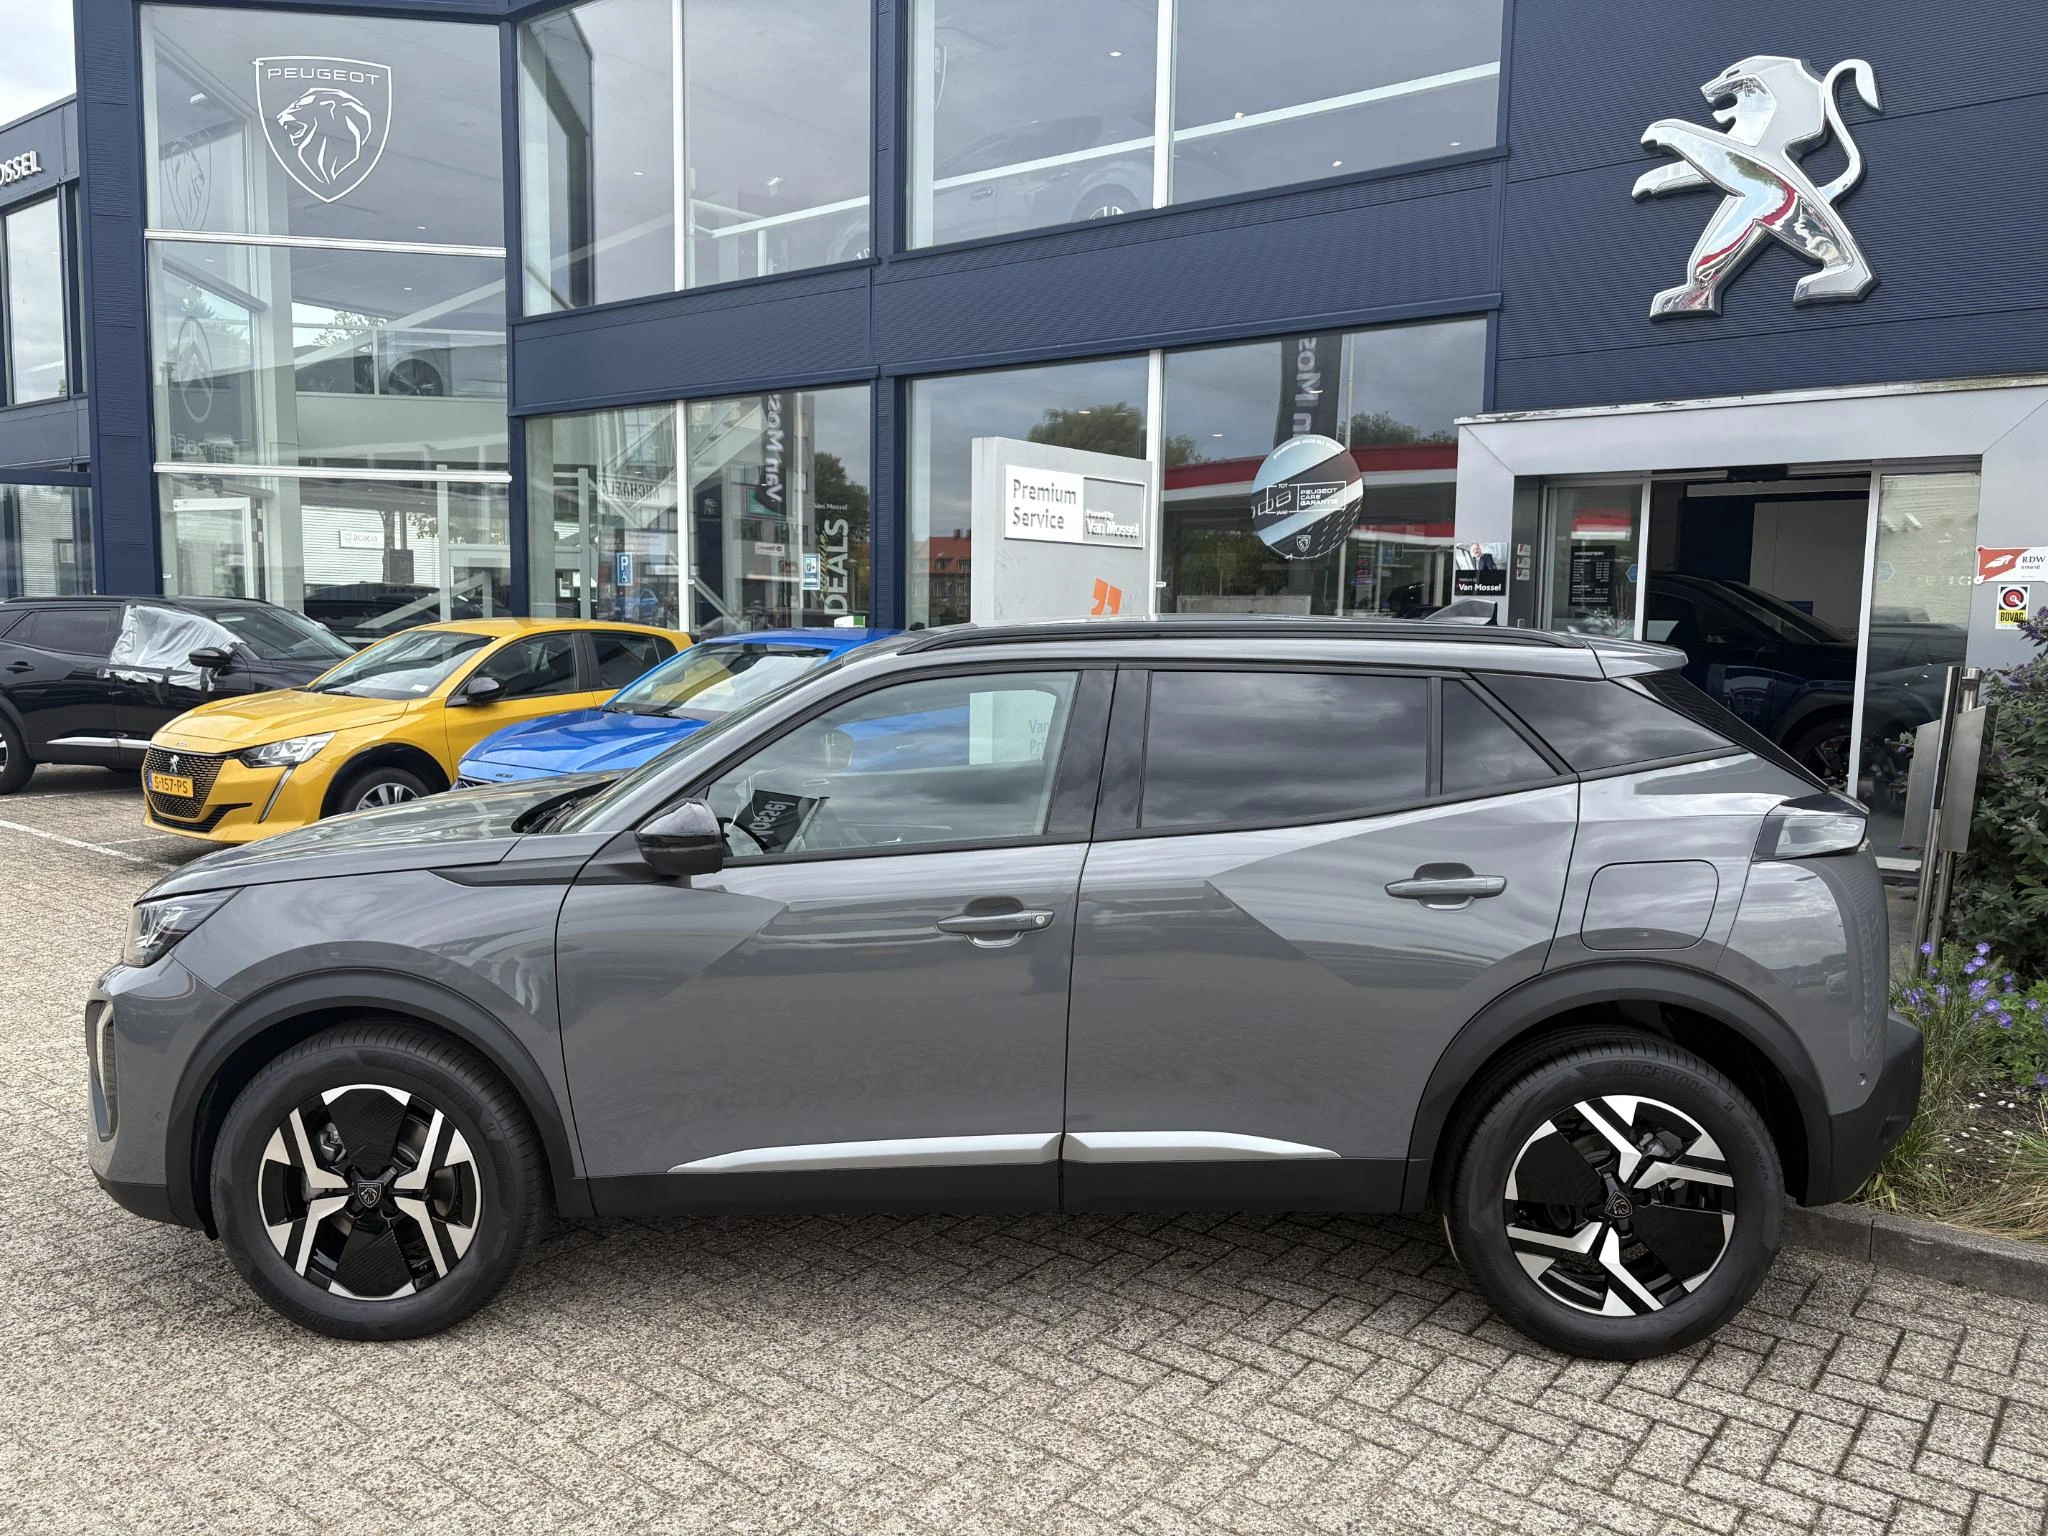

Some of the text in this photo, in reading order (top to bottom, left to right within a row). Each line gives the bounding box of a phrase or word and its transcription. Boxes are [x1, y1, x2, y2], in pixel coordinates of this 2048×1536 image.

[267, 67, 380, 85] PEUGEOT
[1013, 478, 1077, 504] Premium
[1012, 506, 1065, 530] Service
[1085, 518, 1139, 537] Van Mossel
[620, 556, 629, 571] P
[823, 518, 849, 615] DEALS
[1458, 583, 1502, 591] Van Mossel
[2000, 611, 2024, 621] BOVAG
[154, 775, 189, 794] S-157-PS
